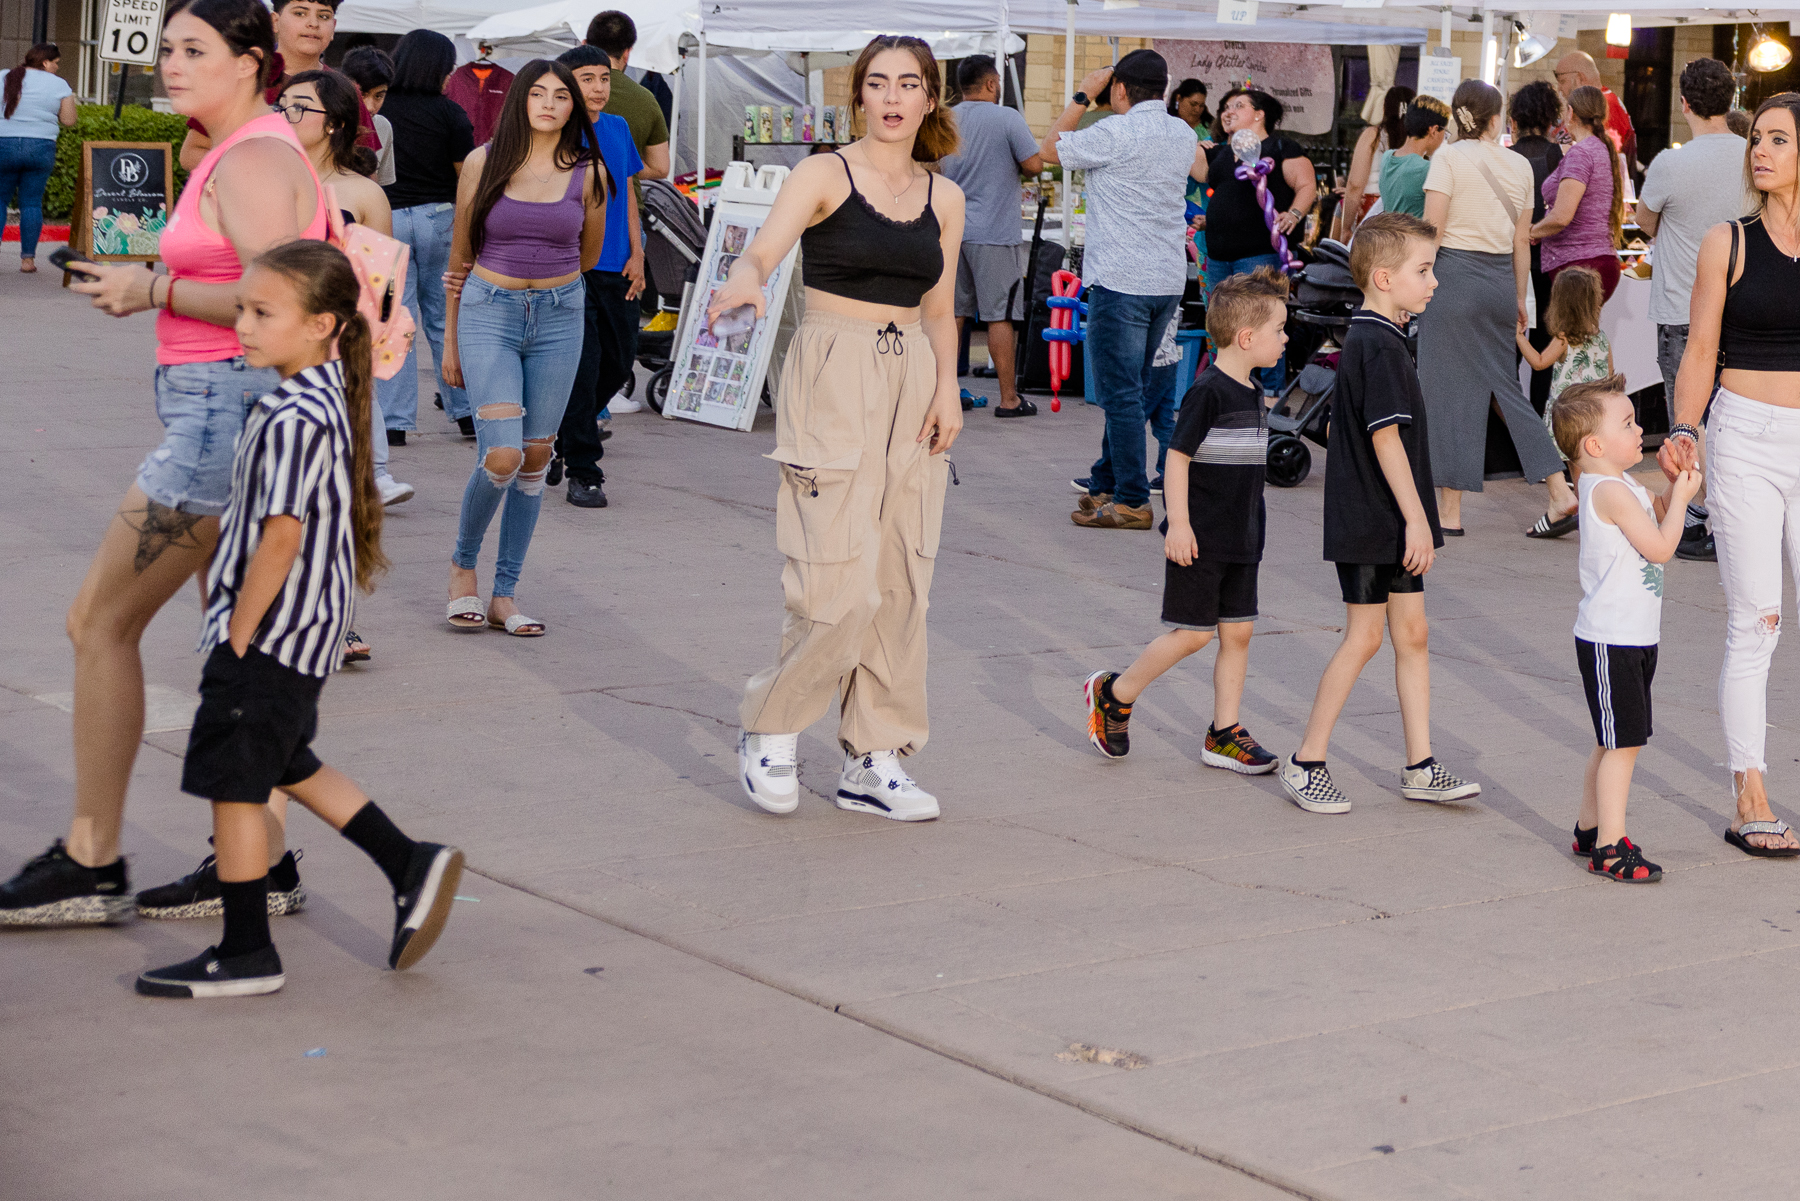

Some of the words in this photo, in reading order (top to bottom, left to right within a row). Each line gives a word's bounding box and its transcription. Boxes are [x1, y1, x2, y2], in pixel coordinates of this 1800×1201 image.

[114, 12, 152, 26] LIMIT
[1231, 10, 1247, 21] UP
[112, 28, 148, 55] 10
[1190, 54, 1212, 74] Lady
[1215, 54, 1245, 70] Glitter
